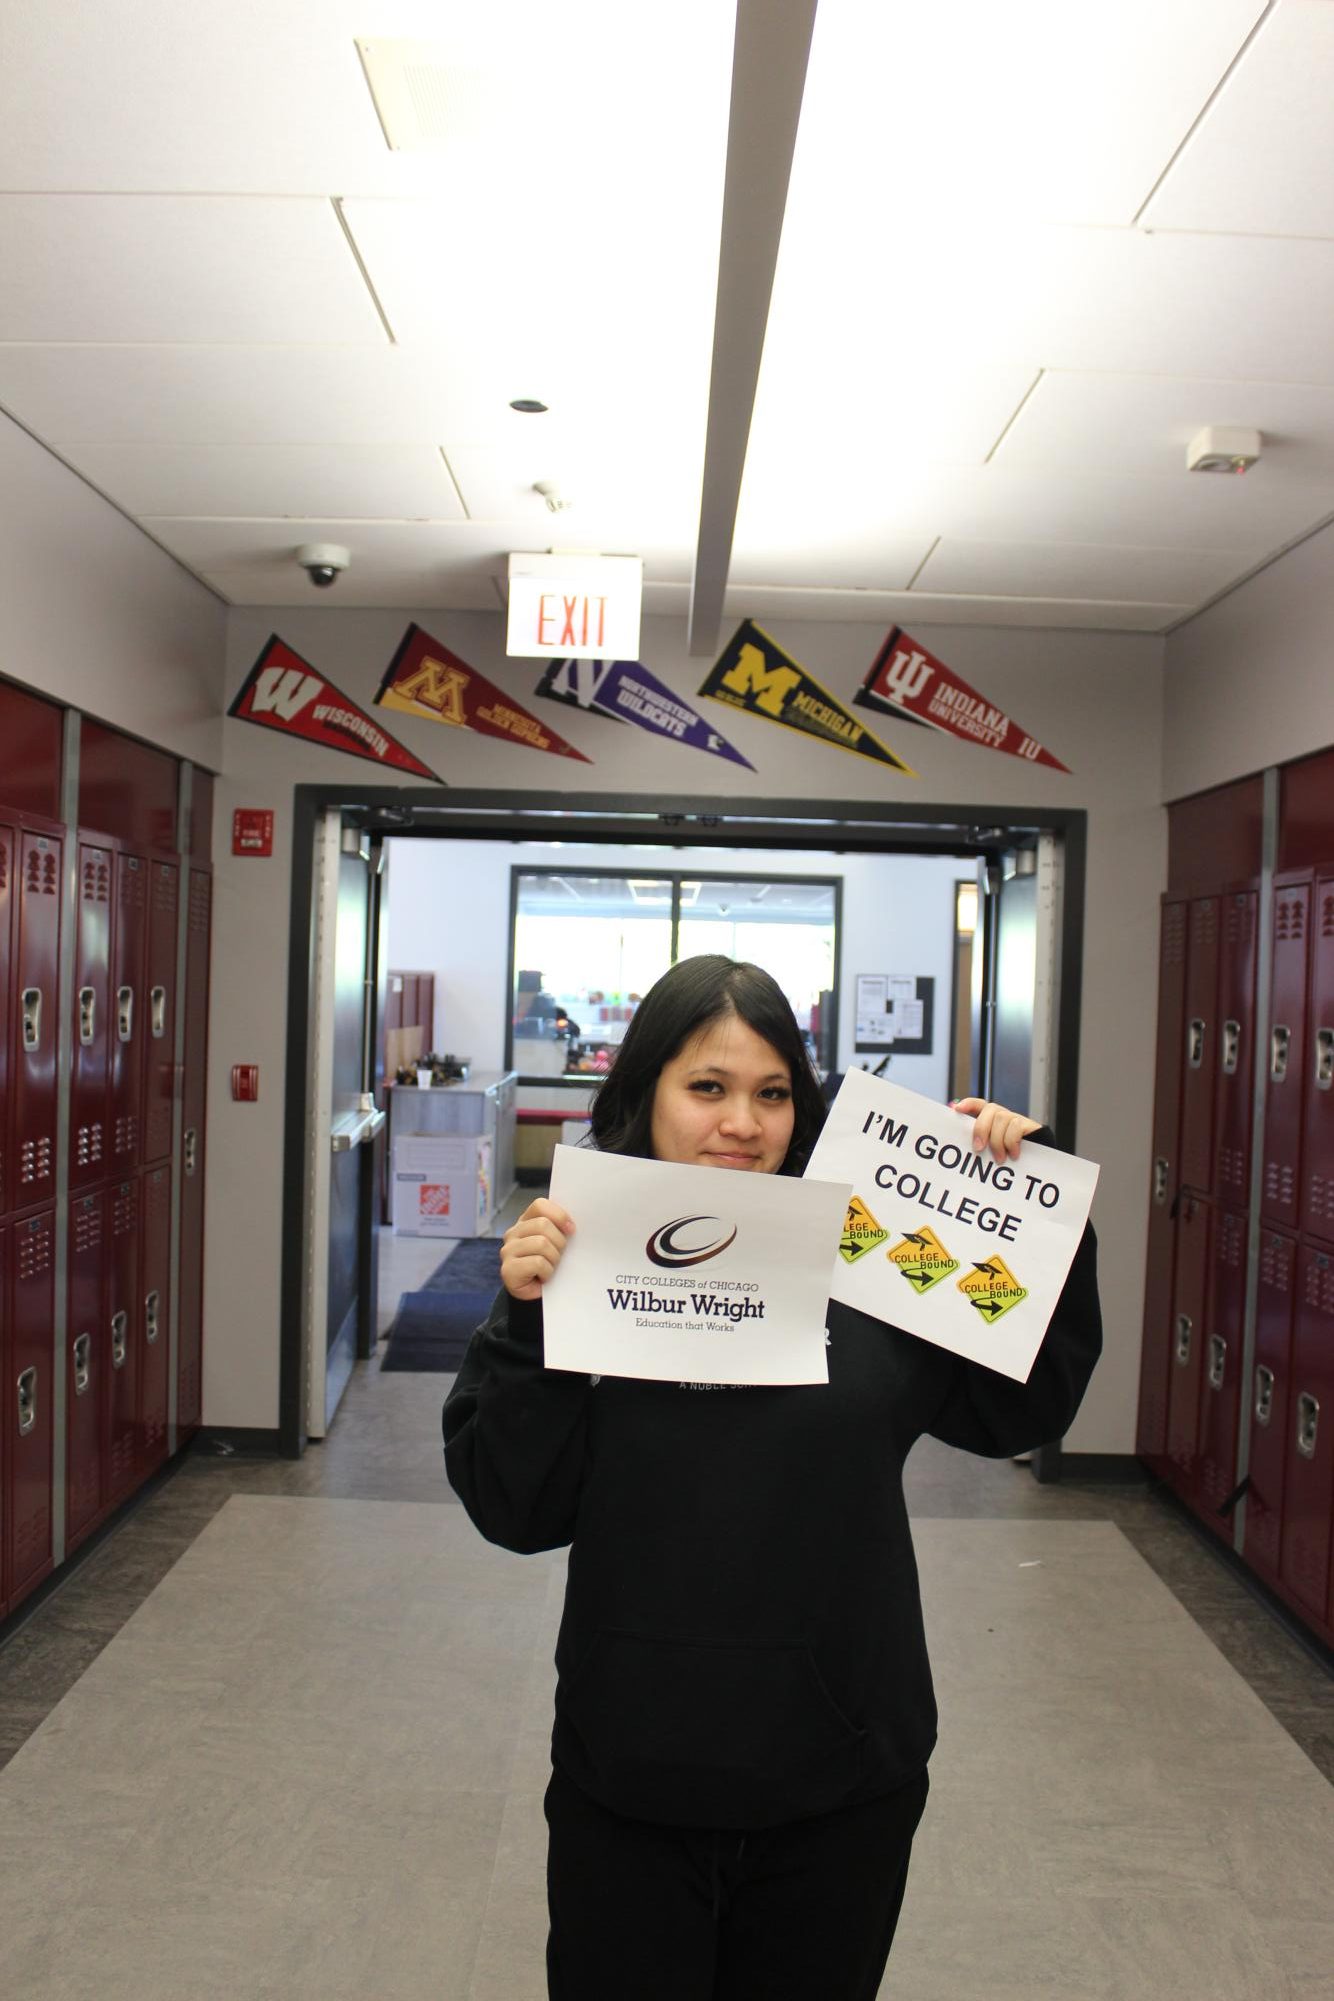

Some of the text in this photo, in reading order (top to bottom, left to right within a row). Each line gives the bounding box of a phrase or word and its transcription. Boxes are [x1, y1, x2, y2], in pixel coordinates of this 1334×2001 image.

[537, 594, 608, 648] EXIT
[252, 666, 324, 722] W
[392, 655, 472, 726] M
[721, 643, 803, 716] M
[312, 704, 390, 757] WISCONSIN
[616, 689, 688, 737] WILDCATS
[792, 691, 864, 743] MICHIGAN
[927, 699, 1007, 748] UNIVERSITY
[934, 682, 1011, 736] INDIANA
[1017, 737, 1042, 761] IU
[862, 1110, 1060, 1209] I'M GOING TO
[844, 1222, 869, 1232] LEGE
[875, 1164, 1022, 1242] COLLEGE
[849, 1229, 884, 1239] BOUND
[894, 1253, 939, 1264] COLLEGE
[920, 1258, 955, 1270] BOUND
[607, 1288, 765, 1323] Wilbur Wright
[615, 1274, 760, 1293] CITY COLLEGES of CHICAGO
[964, 1282, 1008, 1294] COLLEGE
[989, 1287, 1024, 1299] BOUND
[635, 1318, 735, 1332] Education that Works
